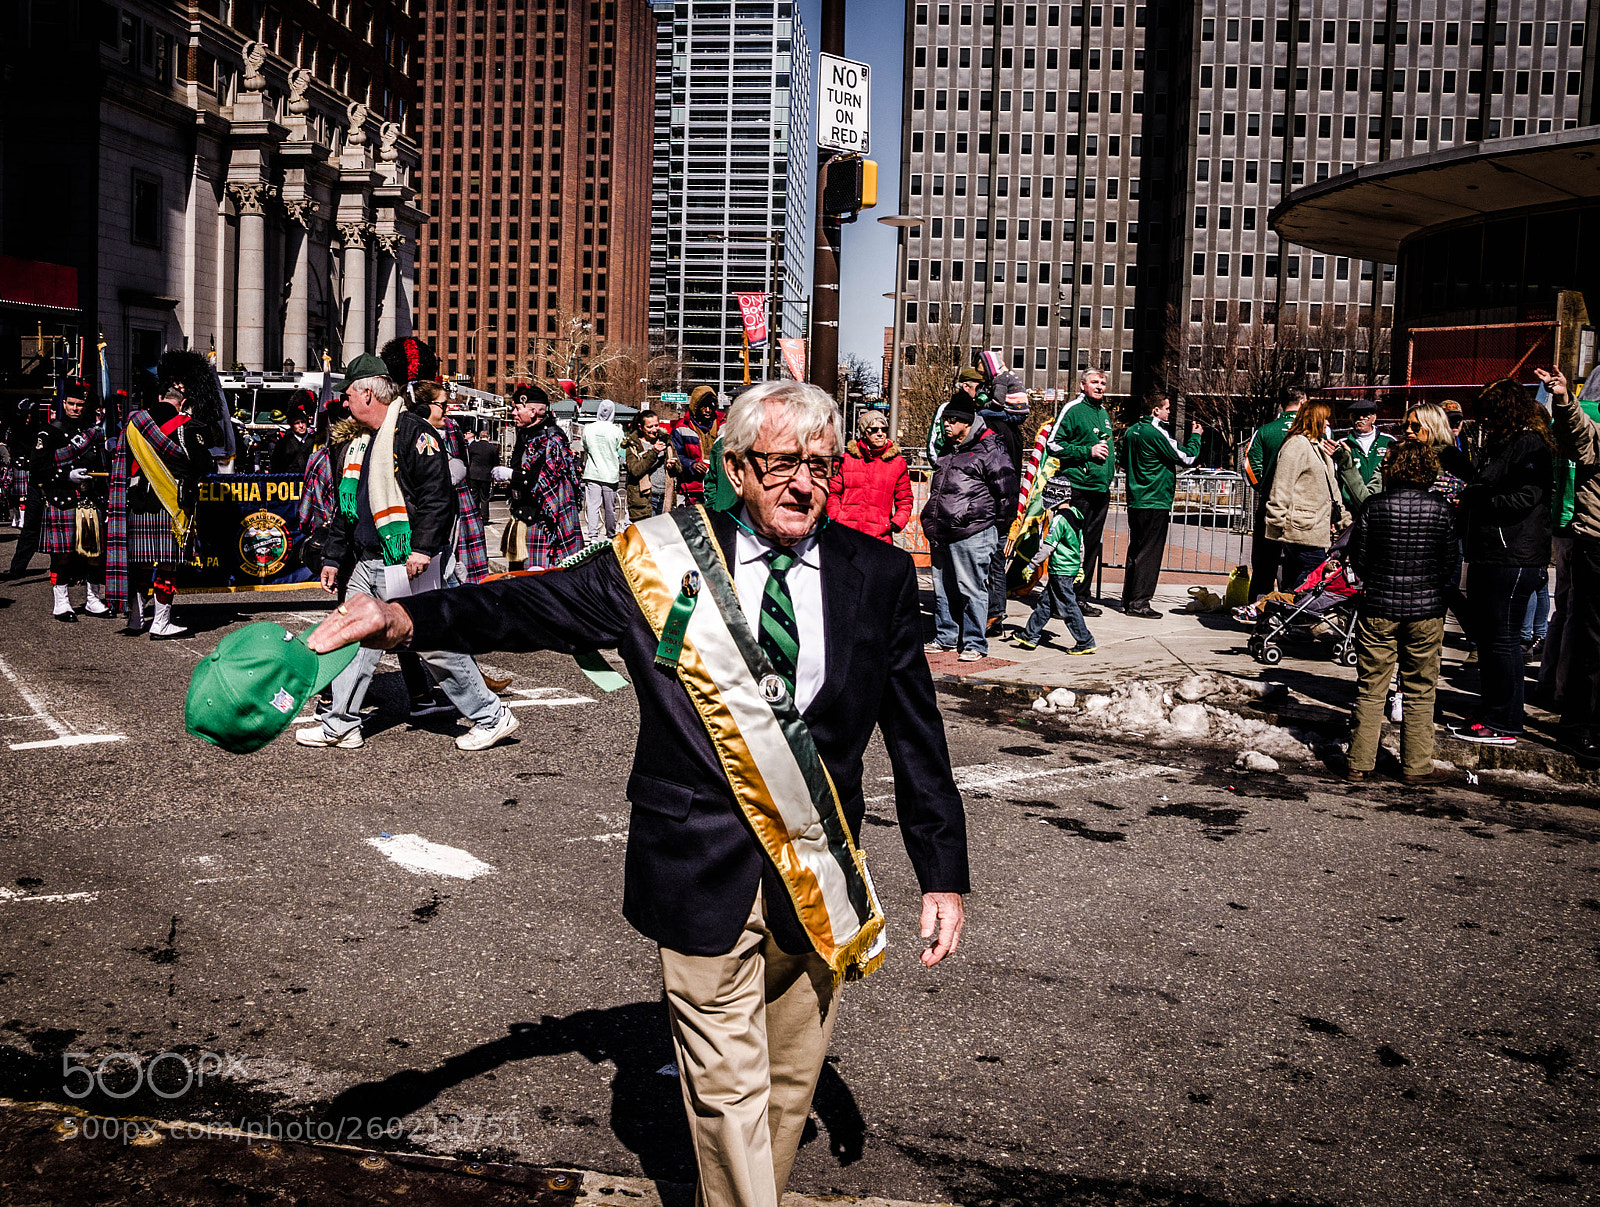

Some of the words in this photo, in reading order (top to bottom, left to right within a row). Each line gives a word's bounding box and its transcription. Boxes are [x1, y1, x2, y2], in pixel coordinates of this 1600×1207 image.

[833, 65, 857, 88] NO
[827, 87, 861, 109] TURN
[836, 109, 853, 125] ON
[832, 126, 858, 143] RED
[207, 557, 219, 567] PA
